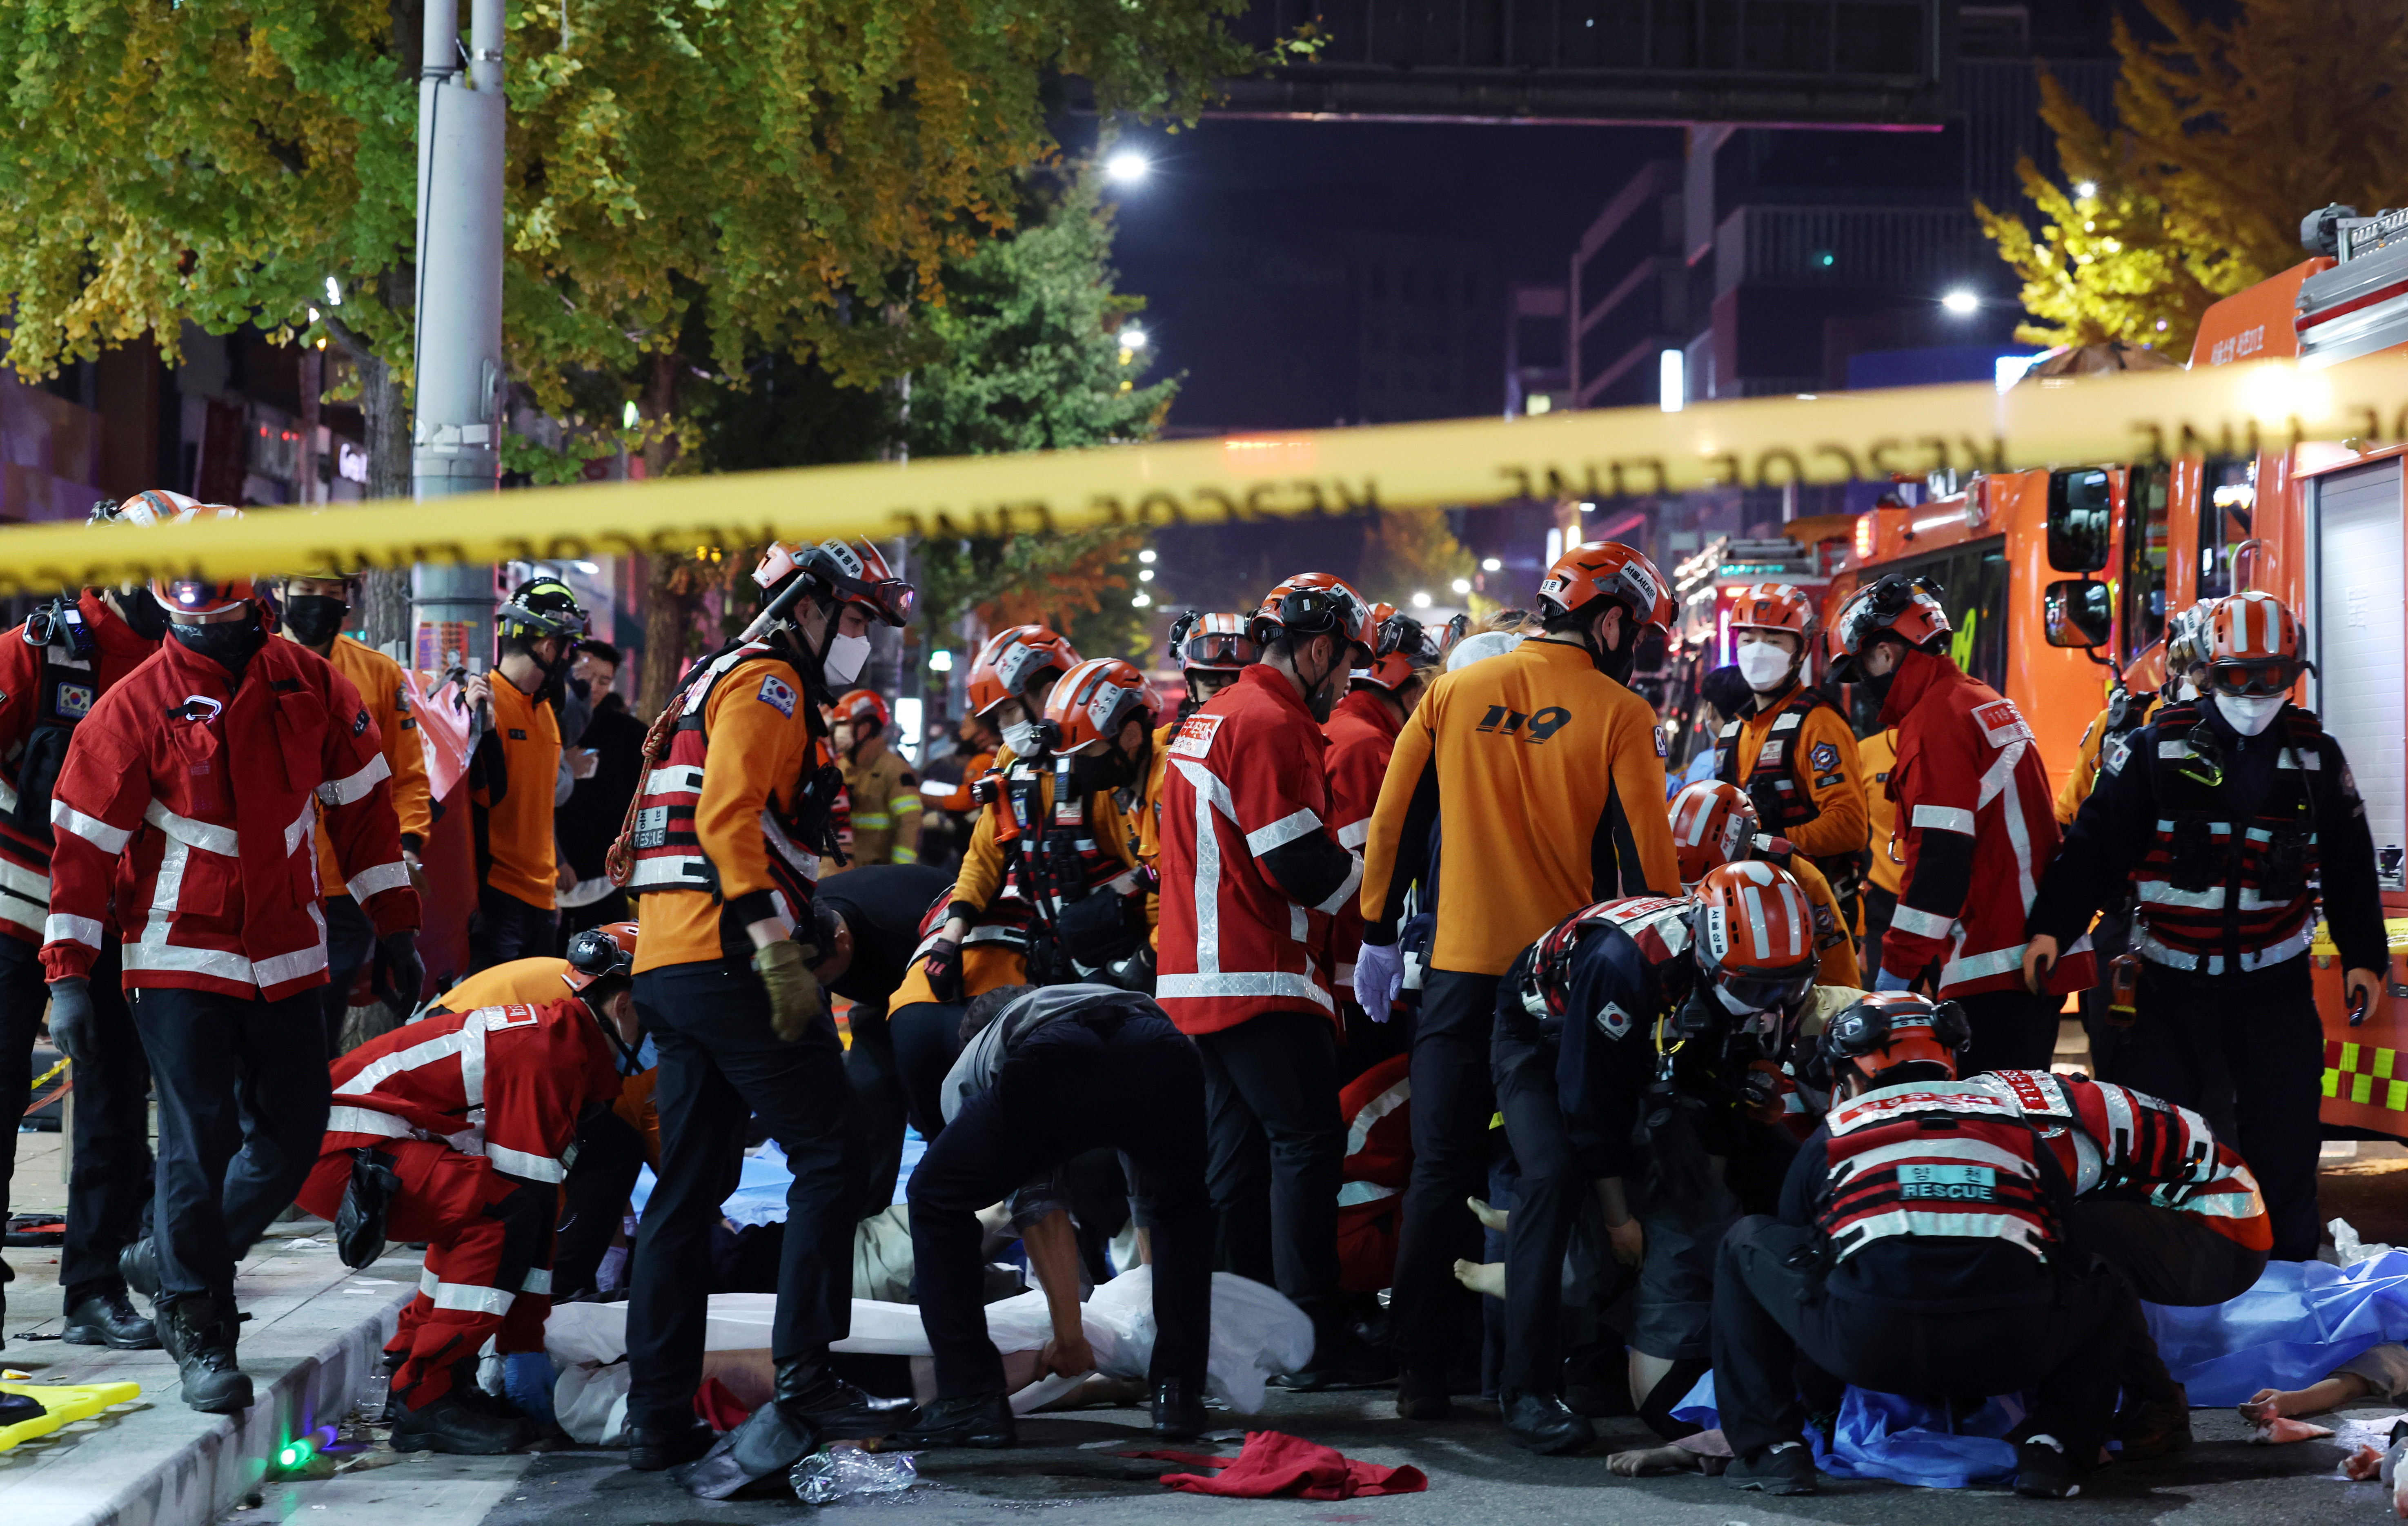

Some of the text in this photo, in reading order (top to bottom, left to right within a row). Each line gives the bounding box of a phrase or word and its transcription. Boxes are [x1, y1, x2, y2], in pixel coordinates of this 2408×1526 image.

[826, 541, 860, 574] 서울중부
[1625, 566, 1655, 599] 서울서대문
[1475, 704, 1571, 744] 119
[1912, 1167, 1981, 1183] 양 천
[1902, 1184, 1993, 1200] RESCUE
